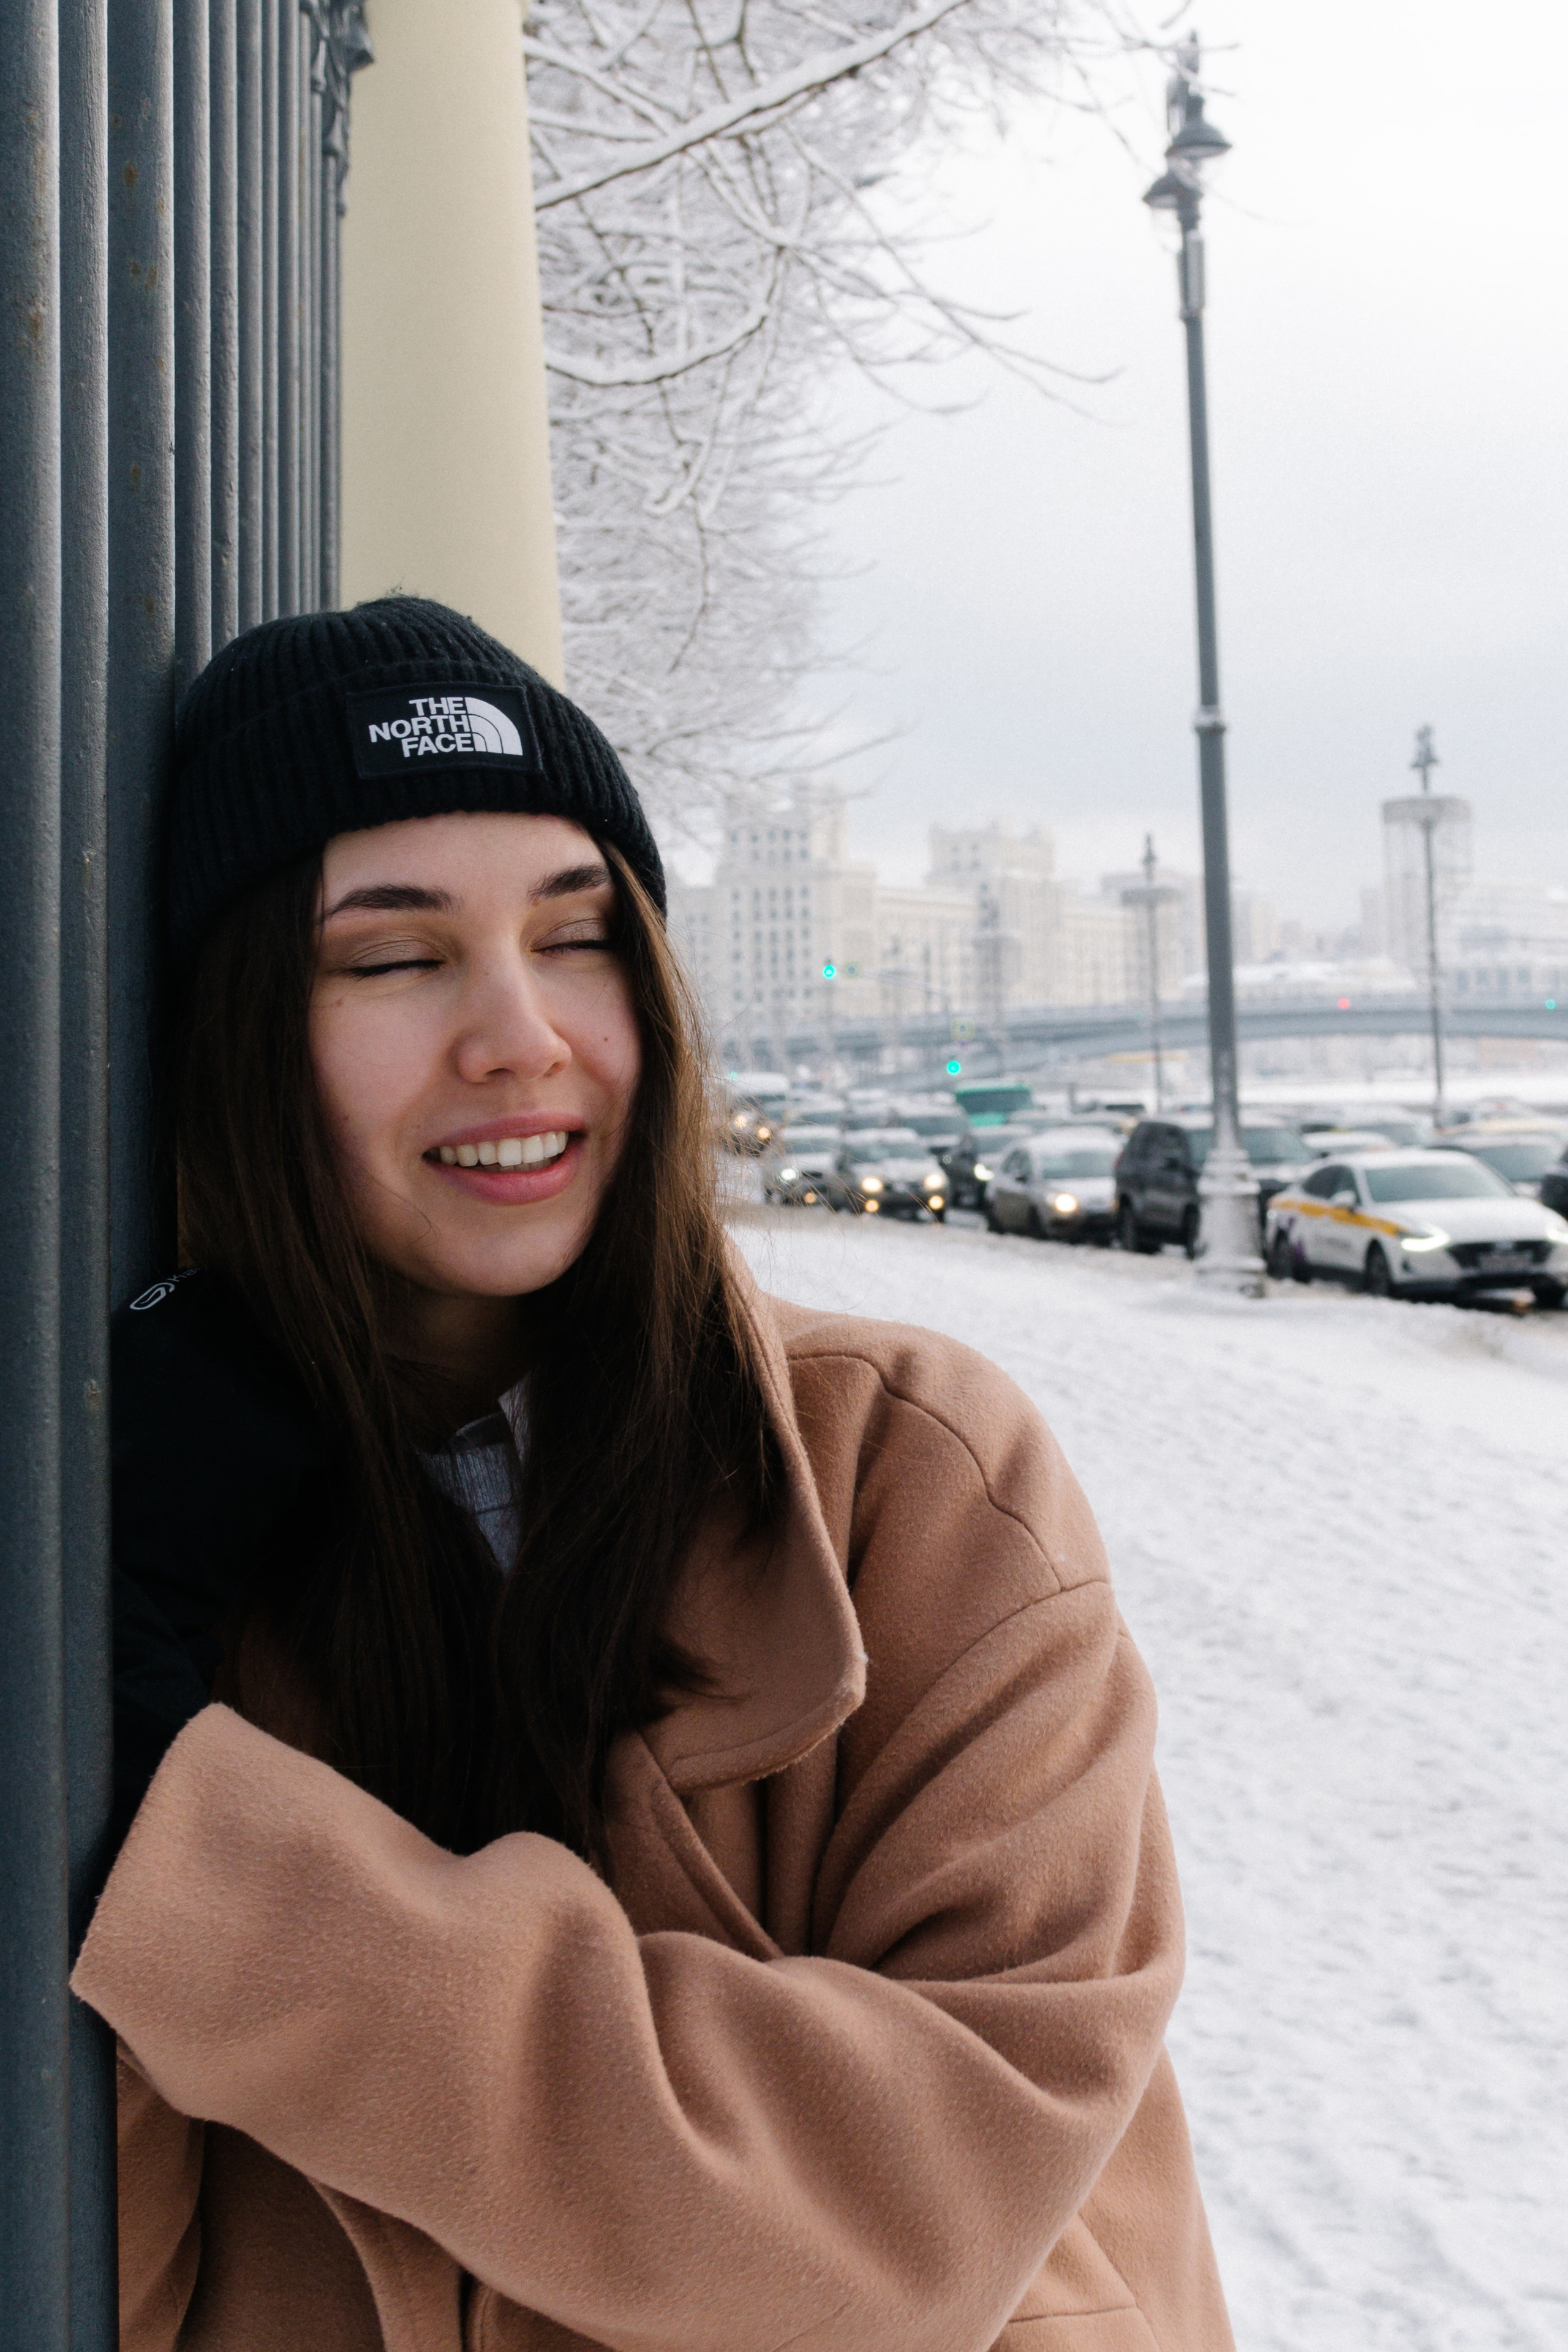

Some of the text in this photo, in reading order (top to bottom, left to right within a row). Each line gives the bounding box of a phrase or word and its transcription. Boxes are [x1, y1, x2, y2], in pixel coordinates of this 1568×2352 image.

[409, 696, 466, 717] THE
[368, 714, 470, 743] NORTH
[401, 733, 475, 758] FACE
